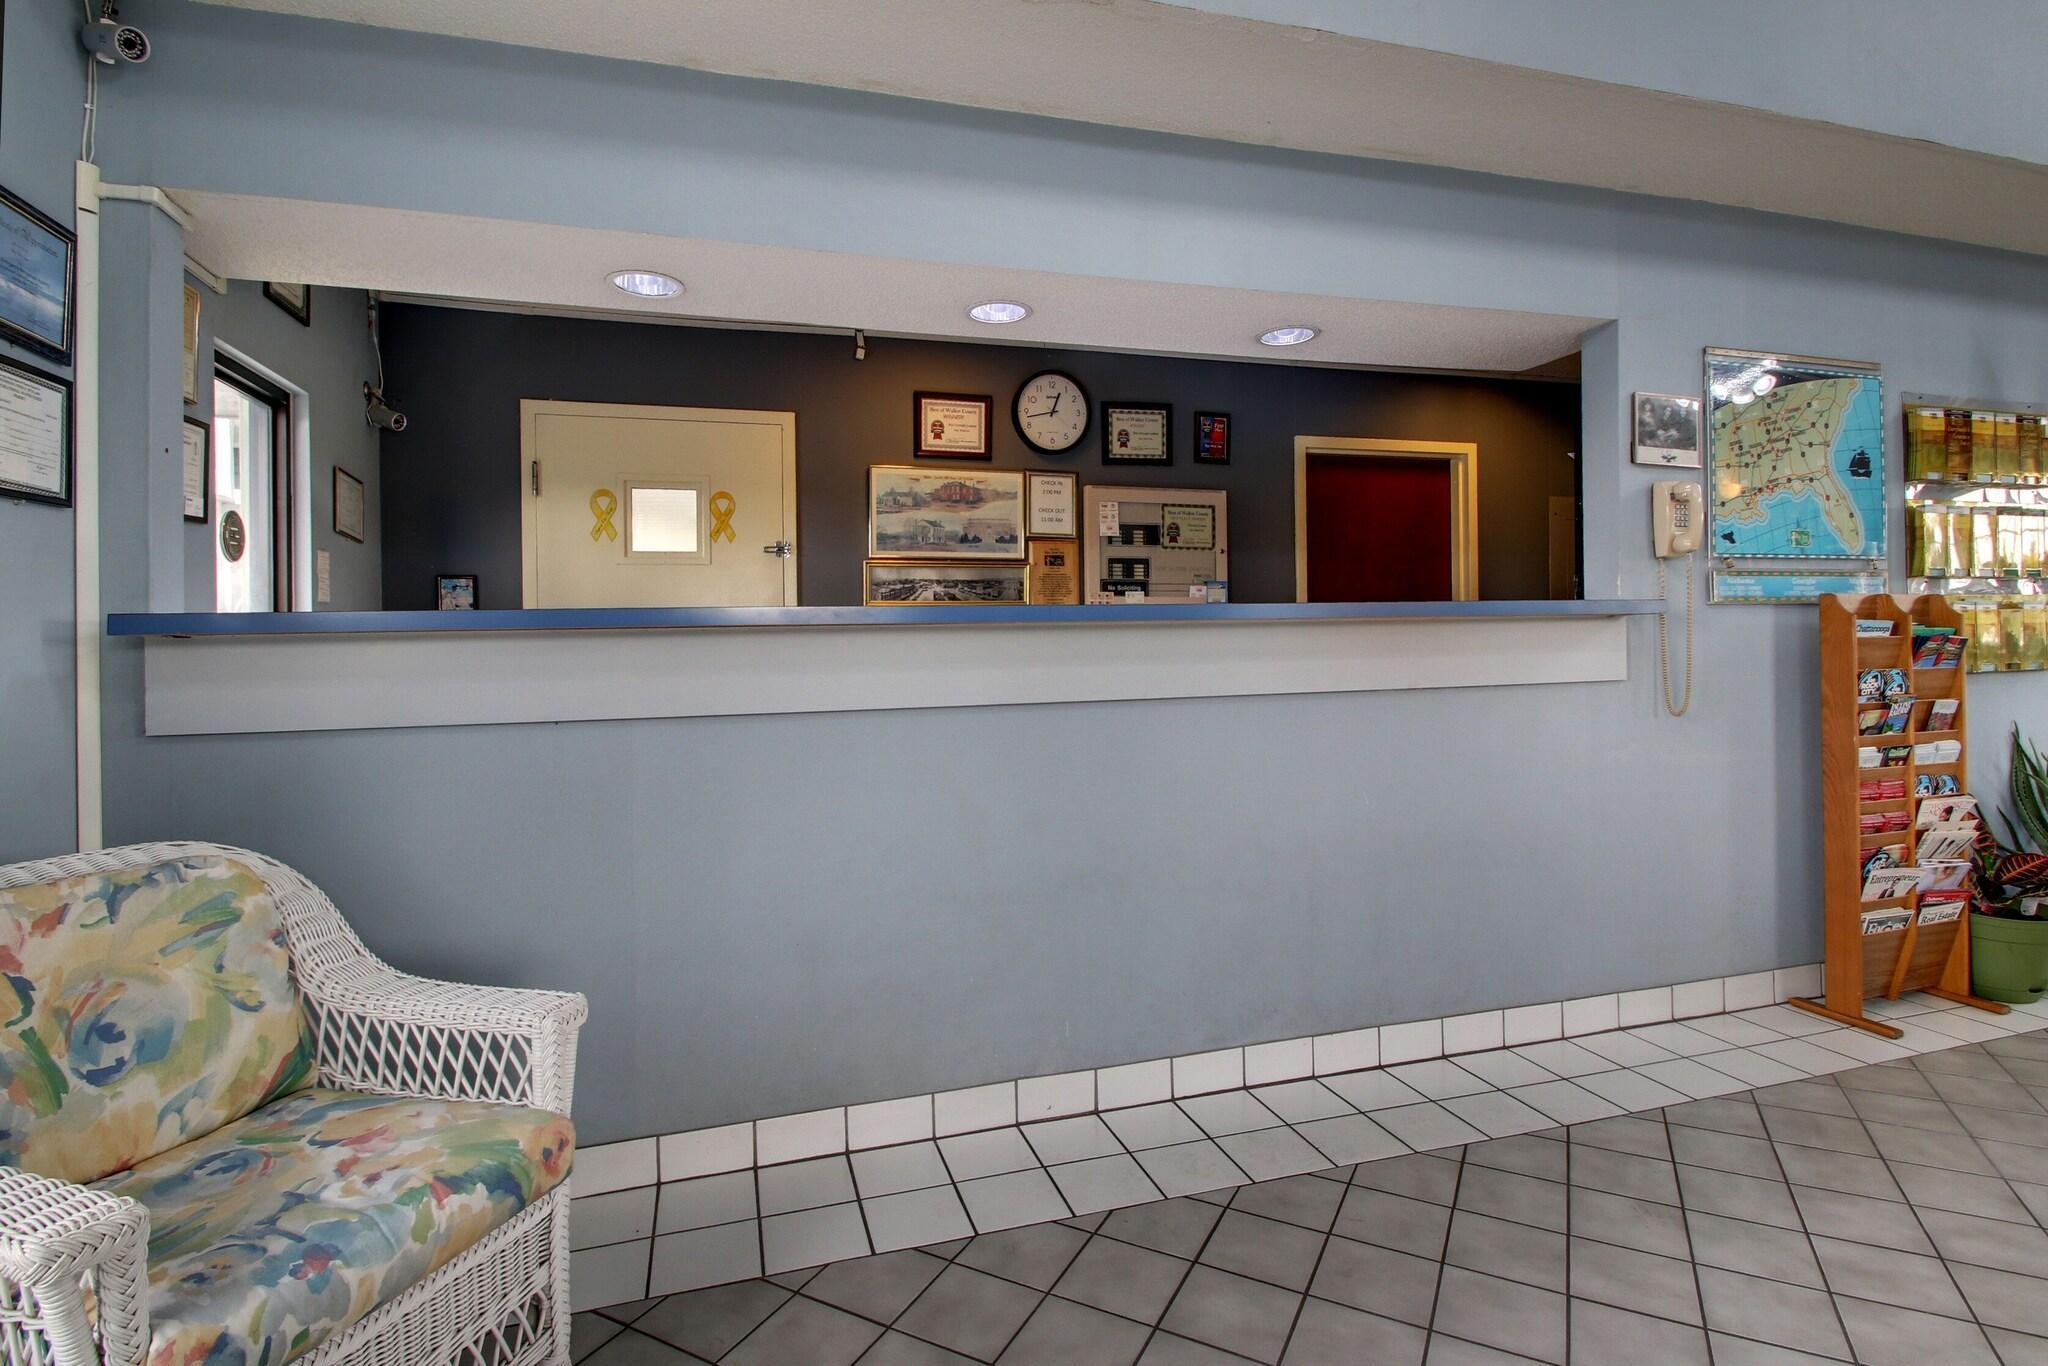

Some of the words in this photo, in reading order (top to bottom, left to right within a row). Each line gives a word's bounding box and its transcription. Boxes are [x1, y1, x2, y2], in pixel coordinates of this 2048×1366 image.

[1048, 381, 1057, 389] 12
[1064, 386, 1068, 394] 1
[1027, 396, 1037, 404] 10
[1072, 395, 1077, 403] 2
[1023, 407, 1029, 415] 9
[1076, 409, 1081, 417] 3
[1026, 422, 1032, 430] 8
[1037, 432, 1042, 440] 7
[1064, 432, 1069, 440] 5
[1050, 437, 1056, 445] 6
[1856, 623, 1890, 634] Chattanooga
[1859, 682, 1879, 690] ROCK
[1920, 914, 1938, 925] Real
[1937, 910, 1959, 921] Estate
